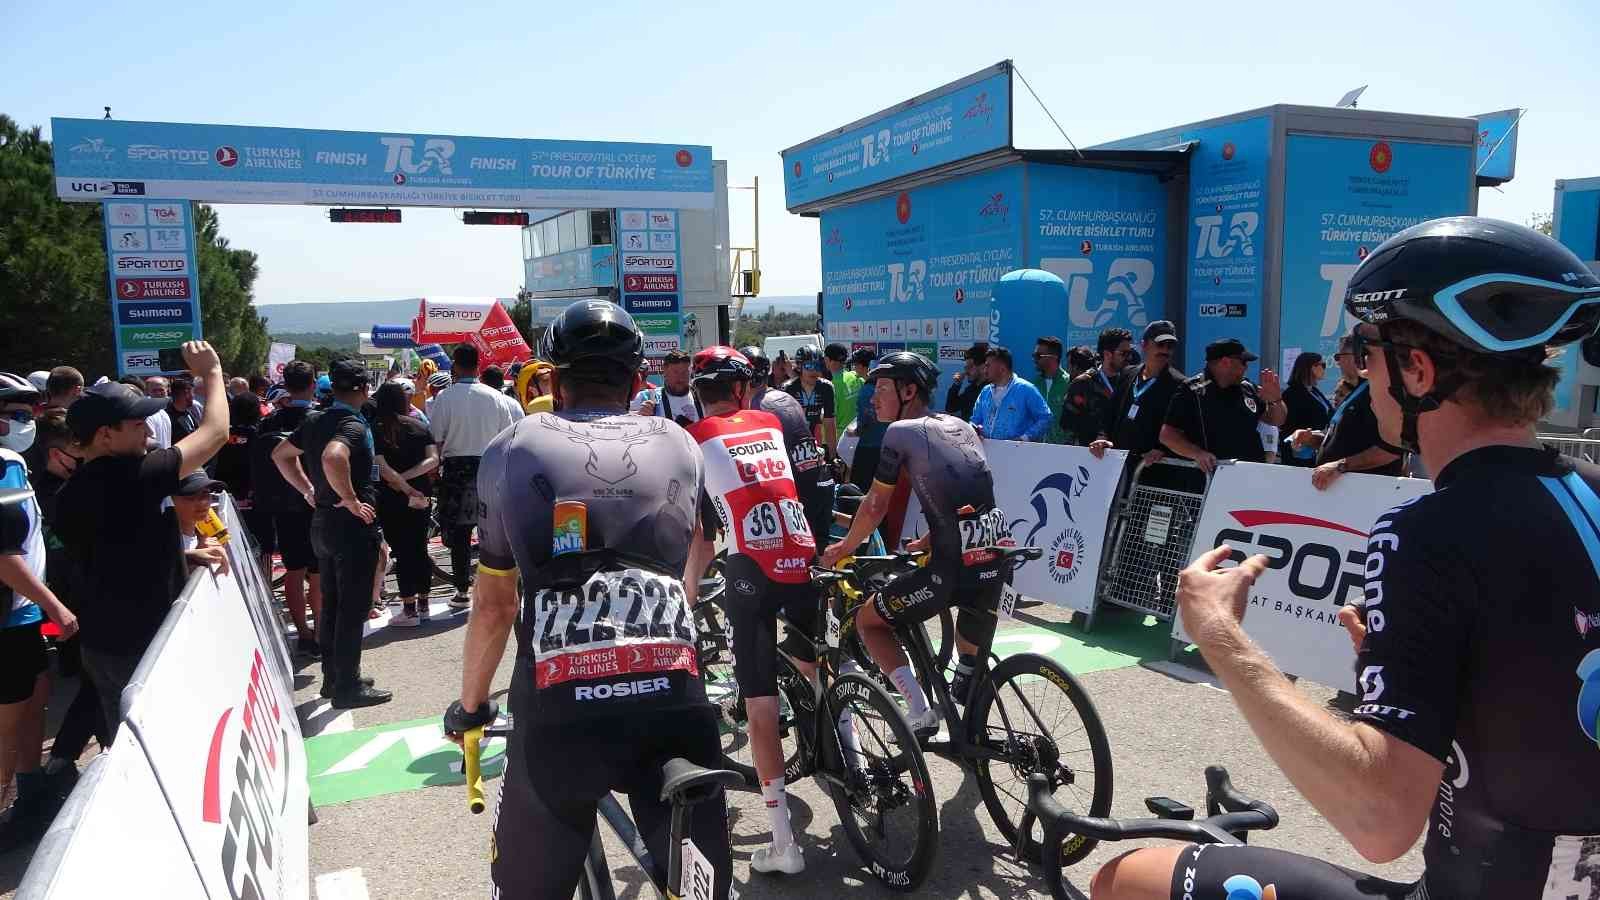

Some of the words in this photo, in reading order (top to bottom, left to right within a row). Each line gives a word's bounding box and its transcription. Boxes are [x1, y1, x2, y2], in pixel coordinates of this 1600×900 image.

[127, 146, 209, 162] SPORTOTO
[245, 147, 300, 158] TURKISH
[315, 151, 367, 166] FINISH
[245, 158, 303, 169] AIRLINES
[470, 157, 516, 170] FINISH
[531, 164, 573, 178] TOUR
[575, 166, 595, 178] OF
[596, 164, 656, 180] TÜRKİYE
[71, 182, 97, 193] UCI
[1039, 209, 1055, 221] 57.
[1321, 213, 1337, 225] 57.
[1039, 222, 1083, 237] TÜRKİYE
[1083, 224, 1126, 238] BİSİKLET
[1126, 227, 1155, 239] TURU
[1320, 227, 1361, 241] TÜRKİYE
[118, 259, 185, 270] SPORTOTO
[625, 257, 674, 267] SPORTOTO
[143, 281, 185, 290] TURKISH
[643, 276, 674, 284] TURKISH
[929, 272, 953, 288] TOUR
[953, 270, 966, 286] OF
[643, 282, 674, 290] AIRLINES
[143, 288, 186, 298] AIRLINES
[1353, 288, 1408, 303] SCOTT
[631, 300, 672, 308] SHIMANO
[128, 309, 182, 318] SHIMANO
[428, 309, 482, 320] SPORTOTO
[132, 331, 185, 341] MOSSO
[728, 441, 779, 459] SOUDAL
[749, 503, 777, 538] 36
[775, 557, 806, 569] CAPS
[902, 585, 935, 607] SARIS
[618, 576, 692, 642] 222
[1001, 591, 1014, 615] 225
[539, 578, 617, 655] 222
[567, 647, 618, 667] TURKISH
[567, 659, 619, 676] AIRLINES
[575, 676, 672, 701] ROSIER
[872, 861, 886, 879] DT
[887, 871, 910, 886] SWISS
